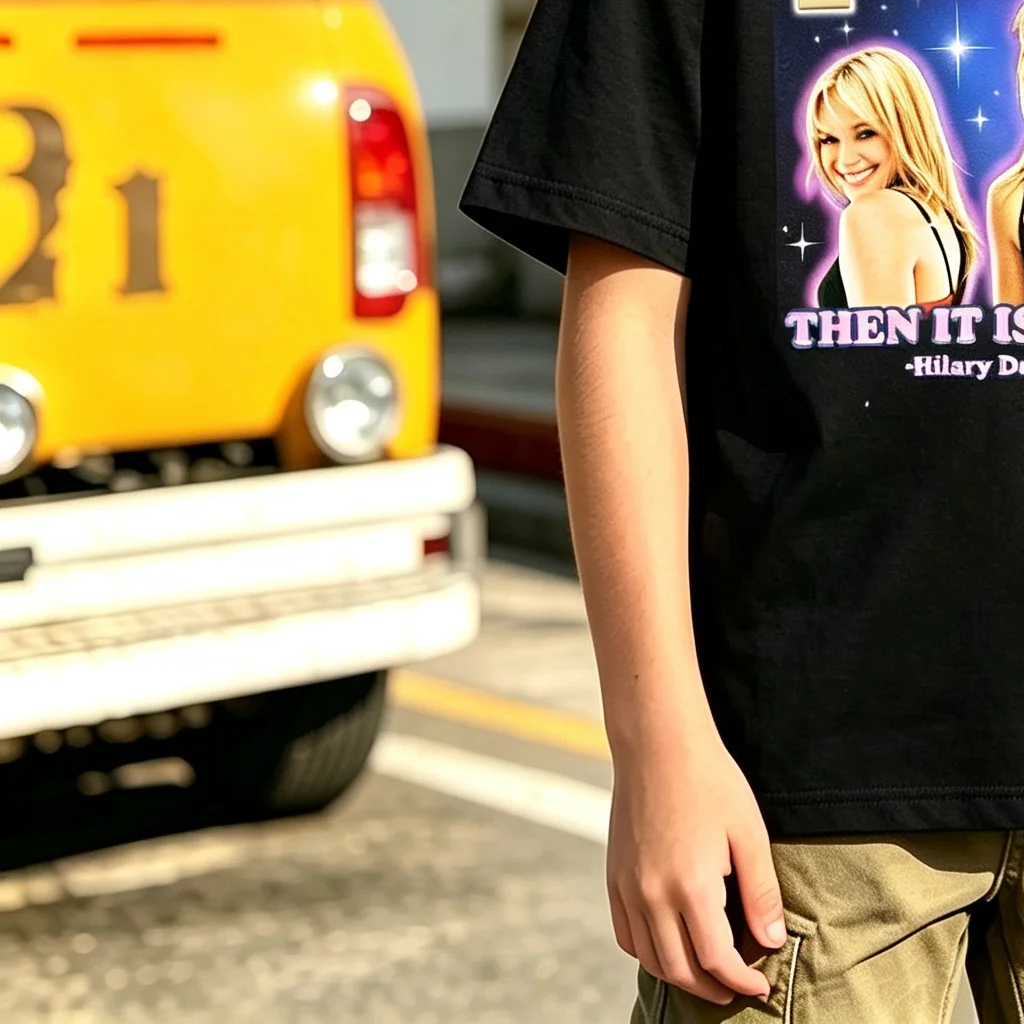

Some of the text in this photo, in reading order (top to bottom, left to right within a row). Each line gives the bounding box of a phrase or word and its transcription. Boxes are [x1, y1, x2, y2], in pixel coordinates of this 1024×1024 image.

[784, 306, 922, 348] THEN
[929, 306, 983, 347] IT
[904, 354, 994, 380] -Hilary
